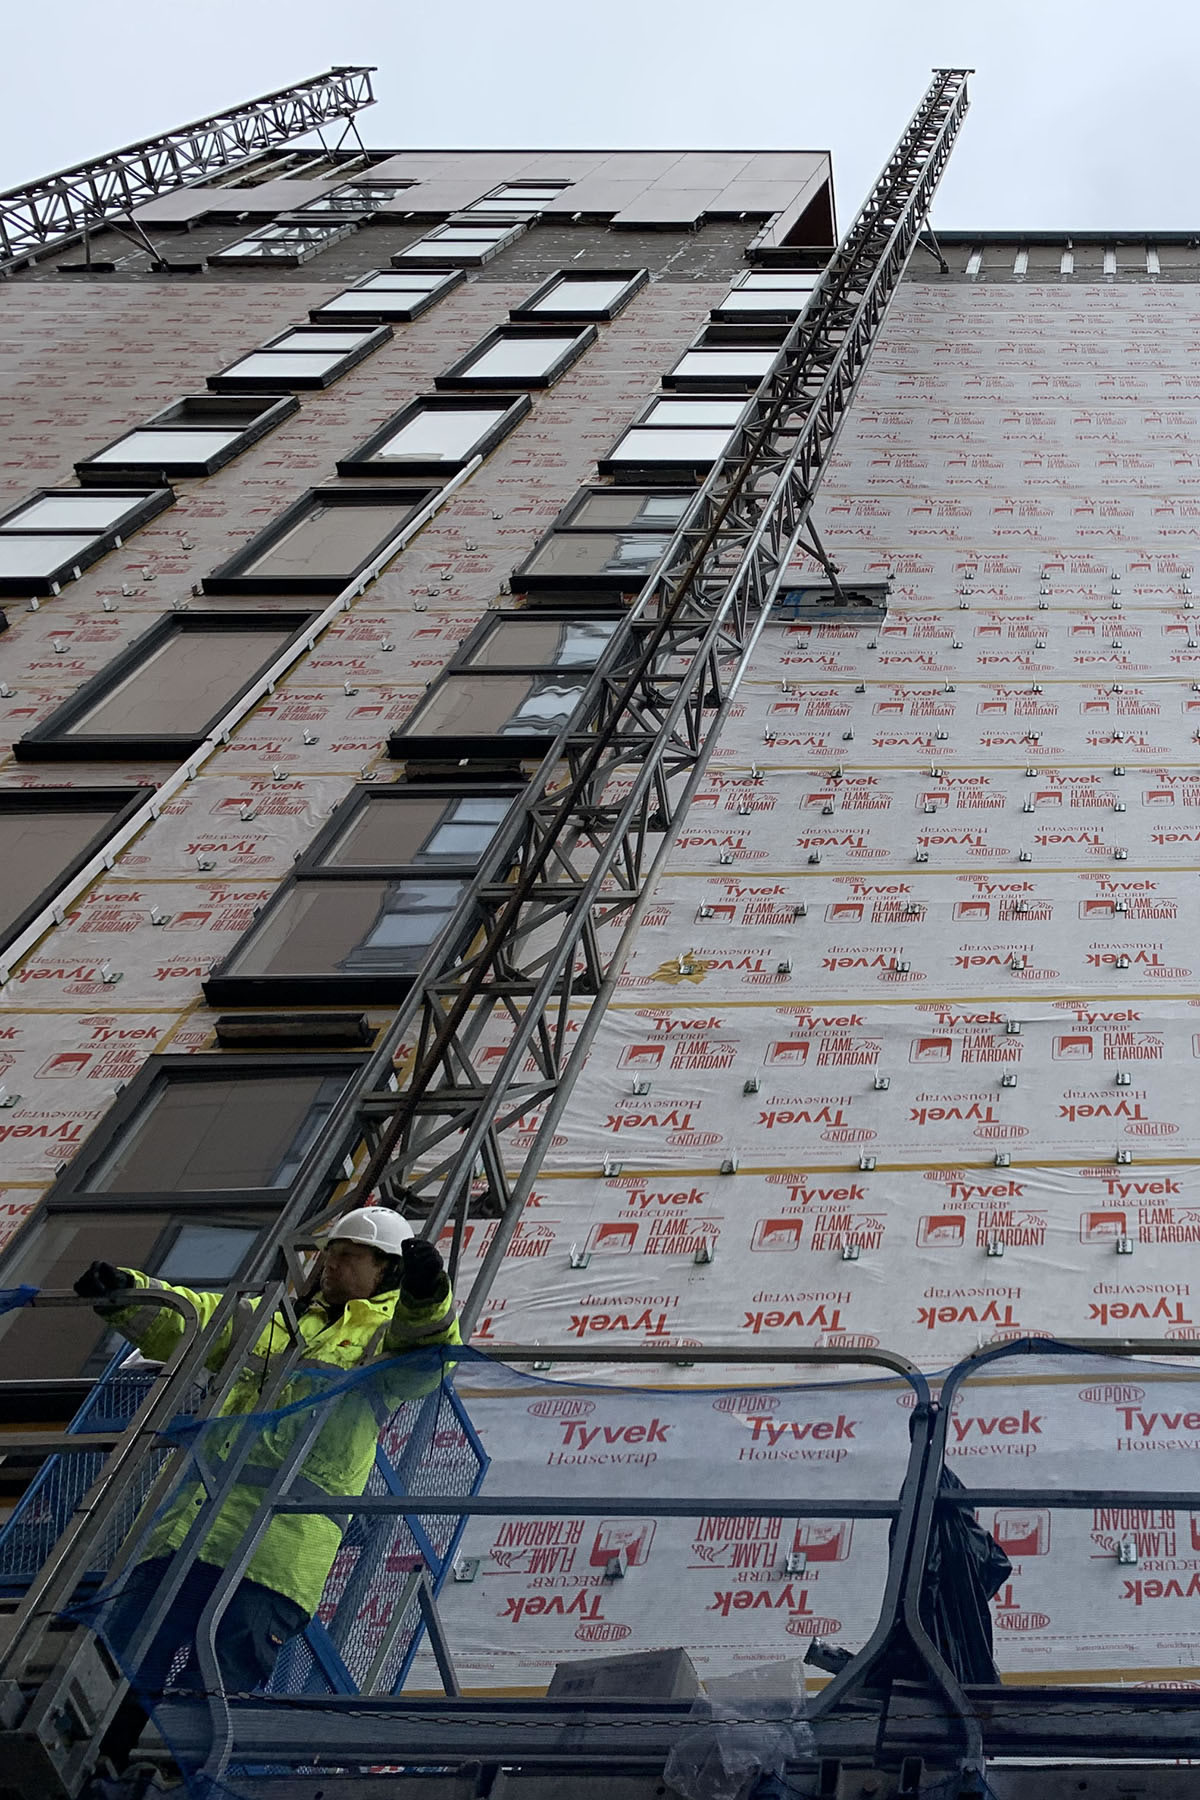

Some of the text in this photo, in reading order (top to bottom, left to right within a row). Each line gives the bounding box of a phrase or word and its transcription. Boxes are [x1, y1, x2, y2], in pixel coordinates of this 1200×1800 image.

[978, 656, 1035, 664] Tyvek
[276, 692, 325, 700] Tyvek
[873, 736, 932, 747] Tyvek
[250, 781, 305, 790] Tyvek
[1046, 774, 1100, 785] Tyvek
[797, 835, 866, 849] Tyvek
[1036, 831, 1103, 847] Tyvek
[186, 842, 256, 854] Tyvek
[209, 891, 270, 901] Tyvek
[724, 884, 785, 896] Tyvek
[975, 881, 1033, 894] Tyvek
[822, 955, 897, 971] Tyvek
[14, 965, 95, 982] Tyvek
[656, 1017, 720, 1032] Tyvek
[798, 1014, 862, 1029] Tyvek
[939, 1010, 1000, 1027] Tyvek
[1077, 1009, 1139, 1024] Tyvek
[93, 1028, 160, 1040] Tyvek
[1104, 1032, 1139, 1049] FLAME
[964, 1035, 994, 1051] FLAME
[1104, 1043, 1163, 1060] RETARDANT
[962, 1045, 1023, 1064] RETARDANT
[760, 1107, 847, 1128] Tyvek
[911, 1104, 1000, 1125] Tyvek
[1060, 1100, 1147, 1121] Tyvek
[606, 1110, 693, 1132] Tyvek
[791, 1184, 864, 1204] Tyvek
[951, 1181, 1023, 1200] Tyvek
[1106, 1178, 1179, 1198] Tyvek
[629, 1188, 704, 1208] Tyvek
[816, 1214, 851, 1235] FLAME
[1139, 1208, 1172, 1224] FLAME
[653, 1219, 688, 1234] FLAME
[753, 1290, 852, 1304] Housewrap
[924, 1288, 1022, 1300] Housewrap
[1093, 1283, 1190, 1296] Housewrap
[580, 1296, 680, 1308] Housewrap
[744, 1305, 845, 1334] Tyvek
[918, 1302, 1019, 1328] Tyvek
[1090, 1296, 1192, 1326] Tyvek
[568, 1309, 670, 1337] Tyvek
[747, 1415, 856, 1446] Tyvek
[950, 1409, 1042, 1442] yvek
[560, 1419, 669, 1451] Tyvek
[739, 1446, 847, 1461] Housewrap
[945, 1443, 1037, 1457] ousewrap
[547, 1451, 656, 1467] Housewrap
[1093, 1508, 1176, 1533] RETARDANT
[493, 1520, 586, 1547] RETARDANT
[696, 1517, 782, 1542] RETARDANT
[1135, 1533, 1176, 1558] FLAME
[528, 1548, 576, 1570] FLAME
[728, 1543, 777, 1567] FLAME
[502, 1589, 603, 1623] Tyvek
[712, 1584, 812, 1616] Tyvek
